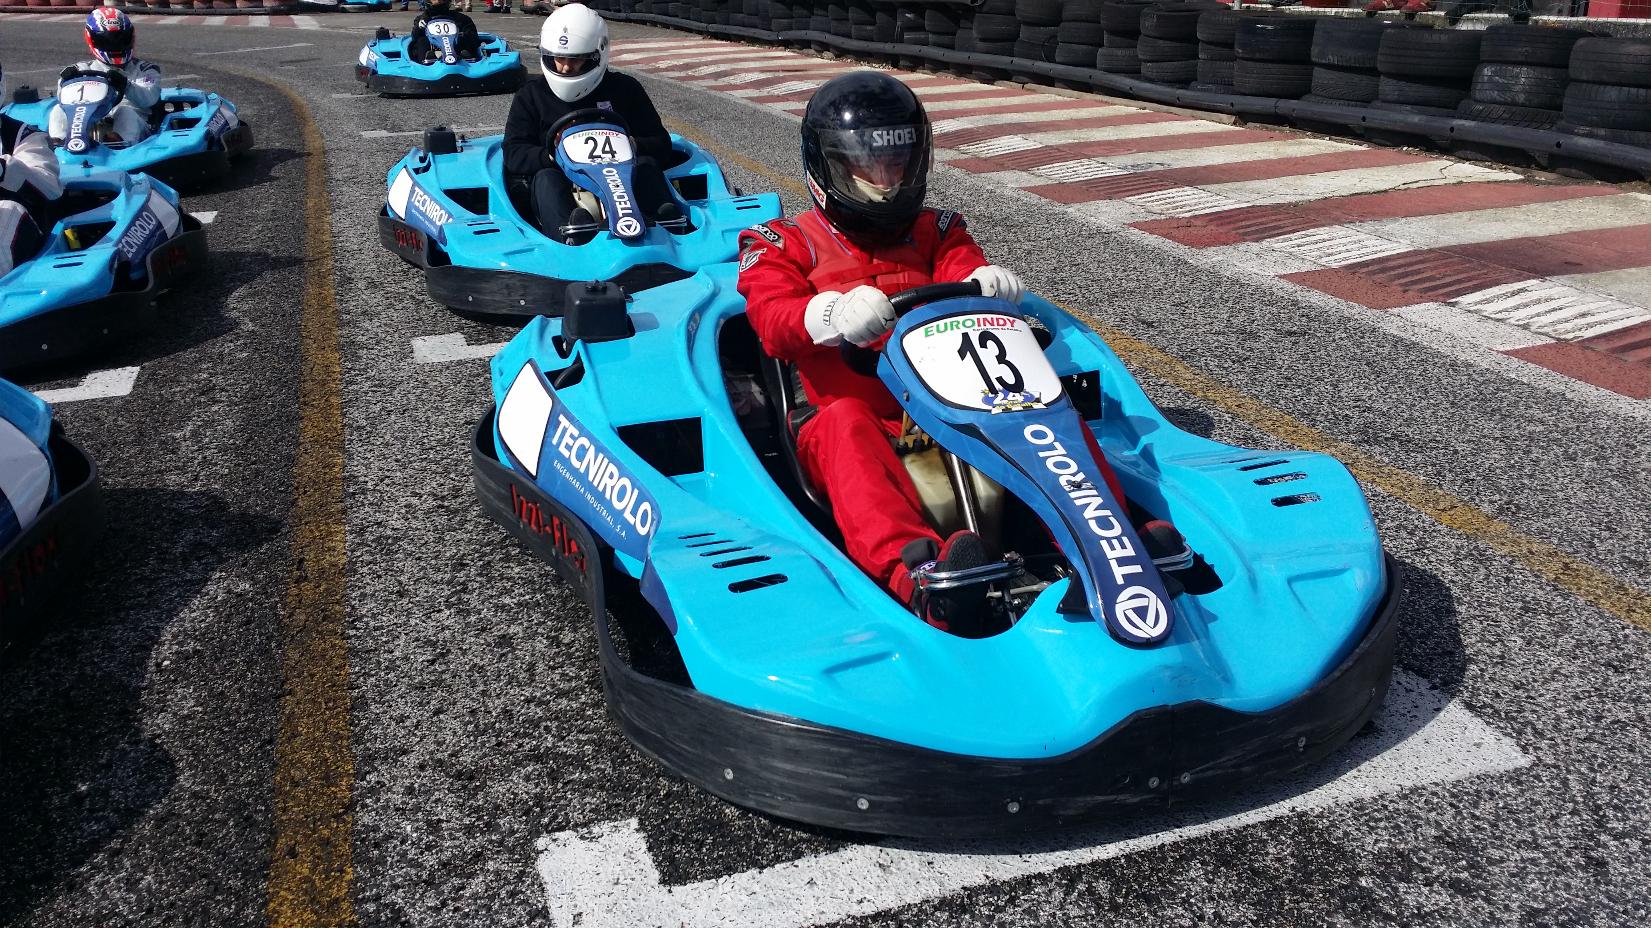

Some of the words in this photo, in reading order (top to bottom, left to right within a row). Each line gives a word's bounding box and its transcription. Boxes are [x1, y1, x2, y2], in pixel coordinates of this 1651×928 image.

[434, 23, 450, 34] 30
[77, 85, 85, 101] 1
[583, 136, 617, 160] 24
[872, 127, 917, 147] SHOEI
[924, 317, 1016, 338] EUROINDY
[956, 330, 1025, 395] 13
[551, 414, 652, 536] TECNIROLO
[553, 459, 585, 494] ENGENHARIA
[615, 524, 628, 540] S.A.
[1023, 424, 1143, 585] TECNIROLO
